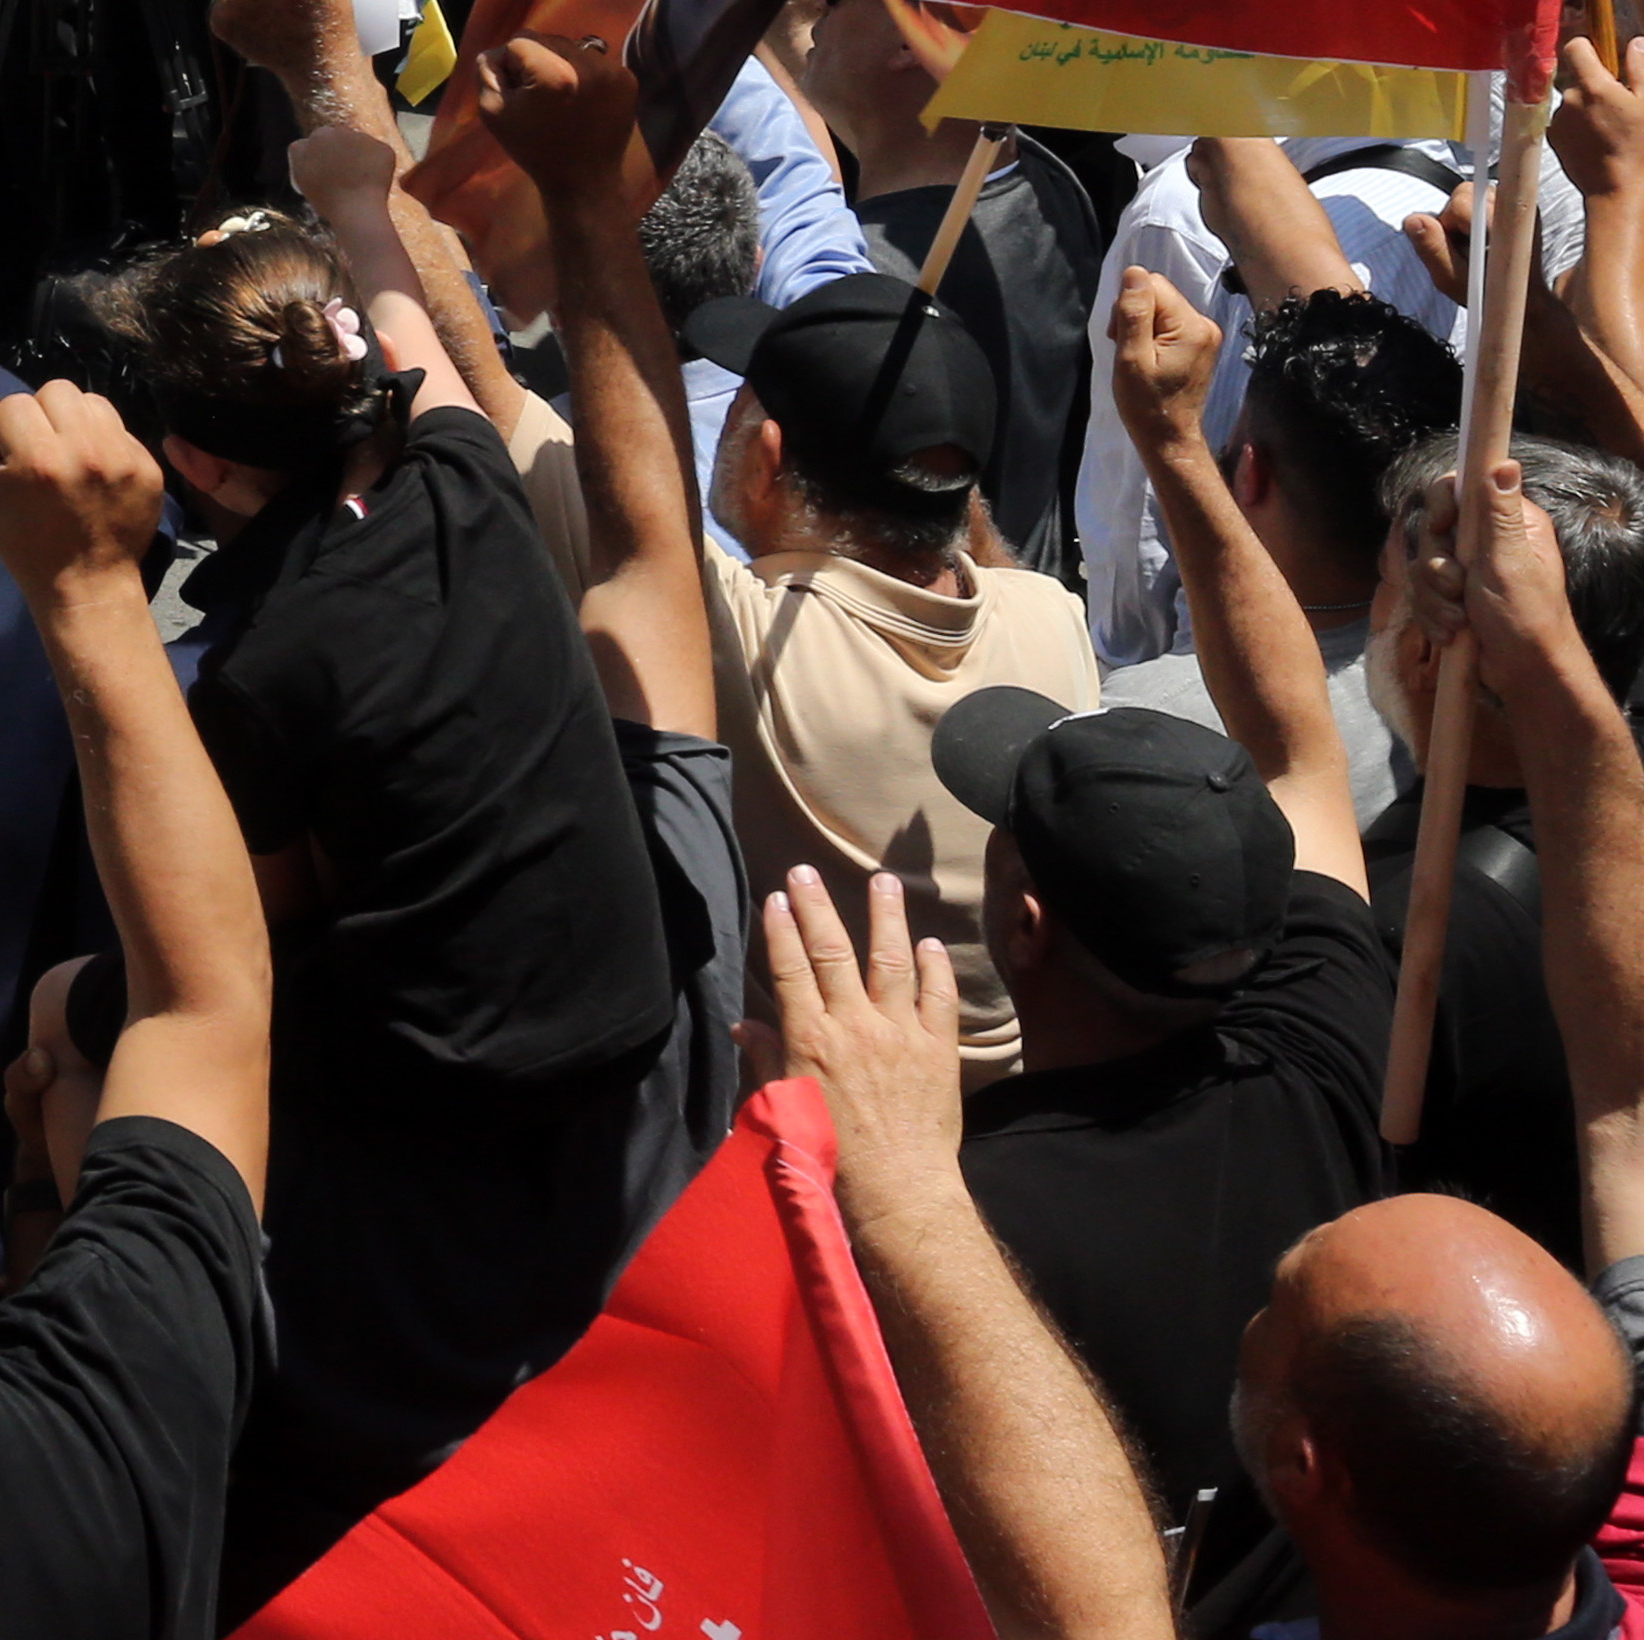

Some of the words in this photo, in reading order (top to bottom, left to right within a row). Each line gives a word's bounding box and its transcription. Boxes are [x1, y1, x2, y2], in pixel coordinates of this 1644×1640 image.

[1018, 40, 1058, 62] لبنان
[1056, 39, 1082, 66] في
[1088, 38, 1164, 66] الإسلامية
